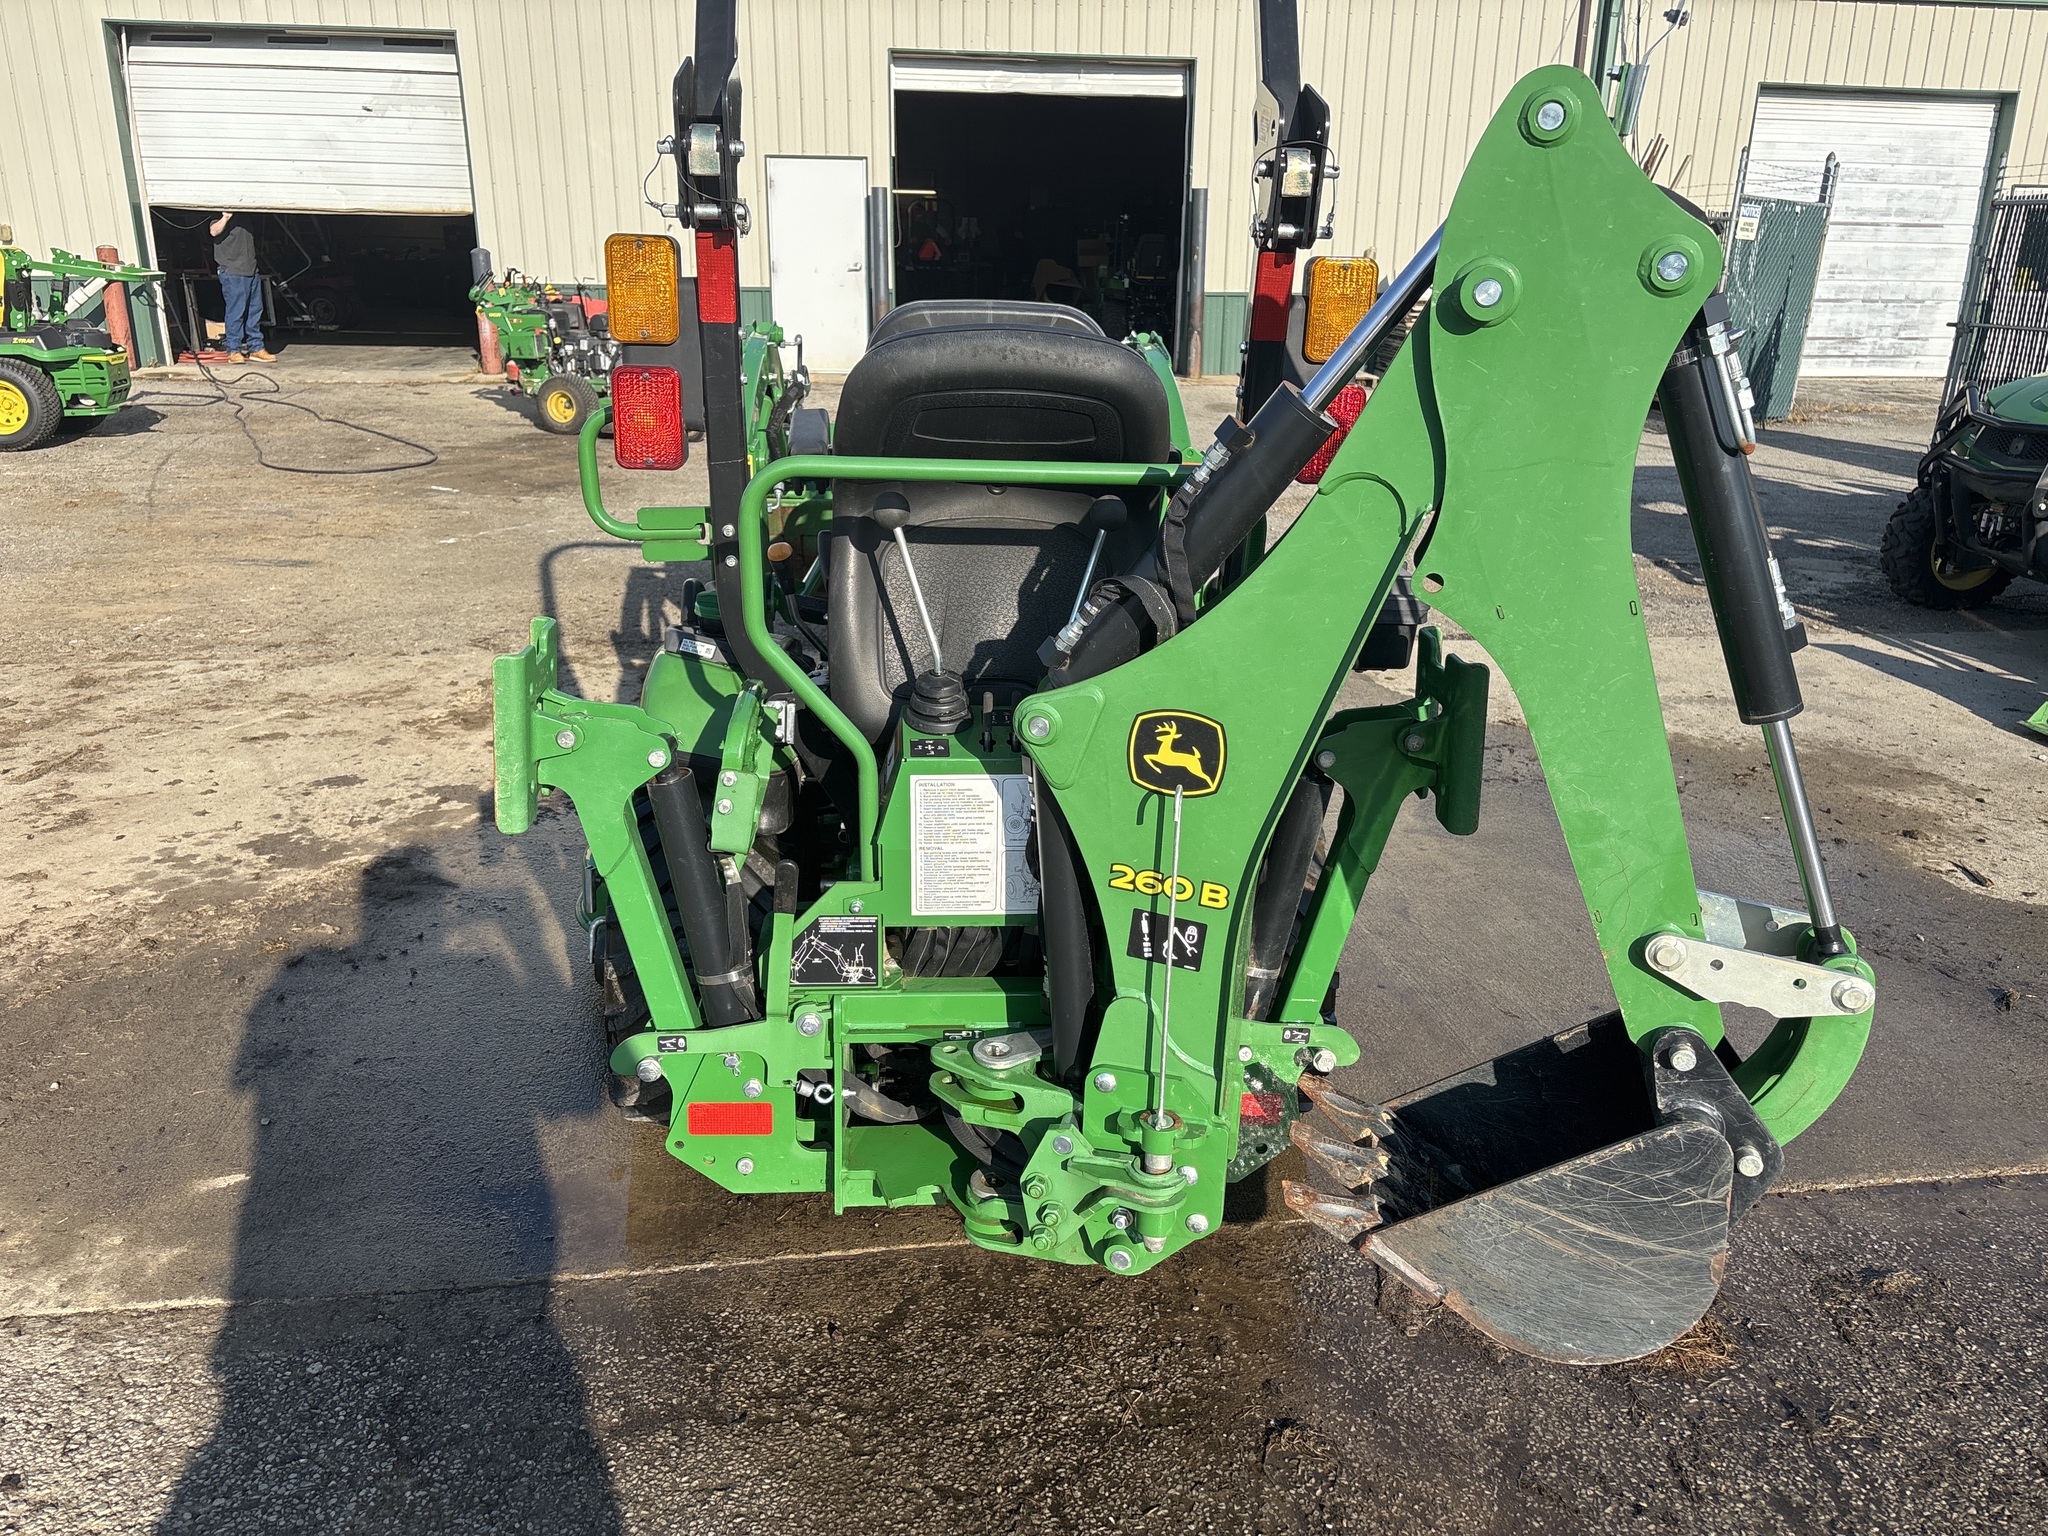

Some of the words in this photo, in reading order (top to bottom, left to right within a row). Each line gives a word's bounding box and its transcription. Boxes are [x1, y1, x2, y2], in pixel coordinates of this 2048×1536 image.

[1741, 206, 1760, 217] NOTICE
[1108, 863, 1195, 902] 260
[1198, 880, 1230, 909] B
